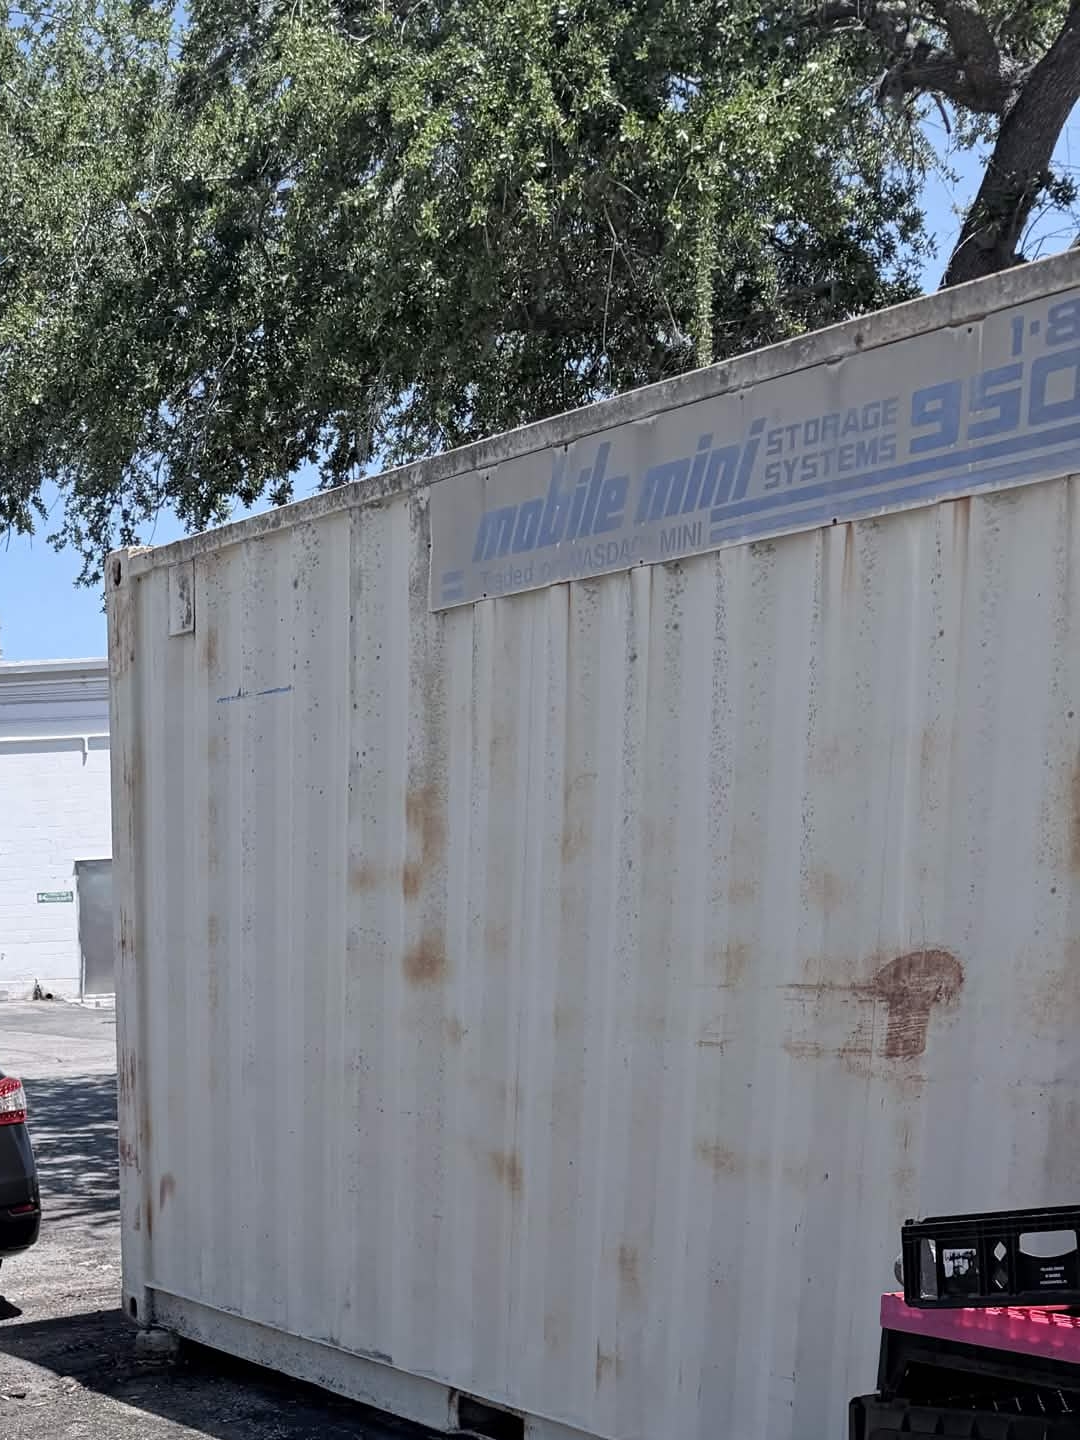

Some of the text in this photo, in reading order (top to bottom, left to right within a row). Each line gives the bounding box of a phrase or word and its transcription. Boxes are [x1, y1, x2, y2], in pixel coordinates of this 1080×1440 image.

[766, 397, 899, 455] STORAGE
[472, 417, 767, 563] mobile mini
[763, 432, 897, 490] SYSTEMS
[659, 520, 703, 553] MINI
